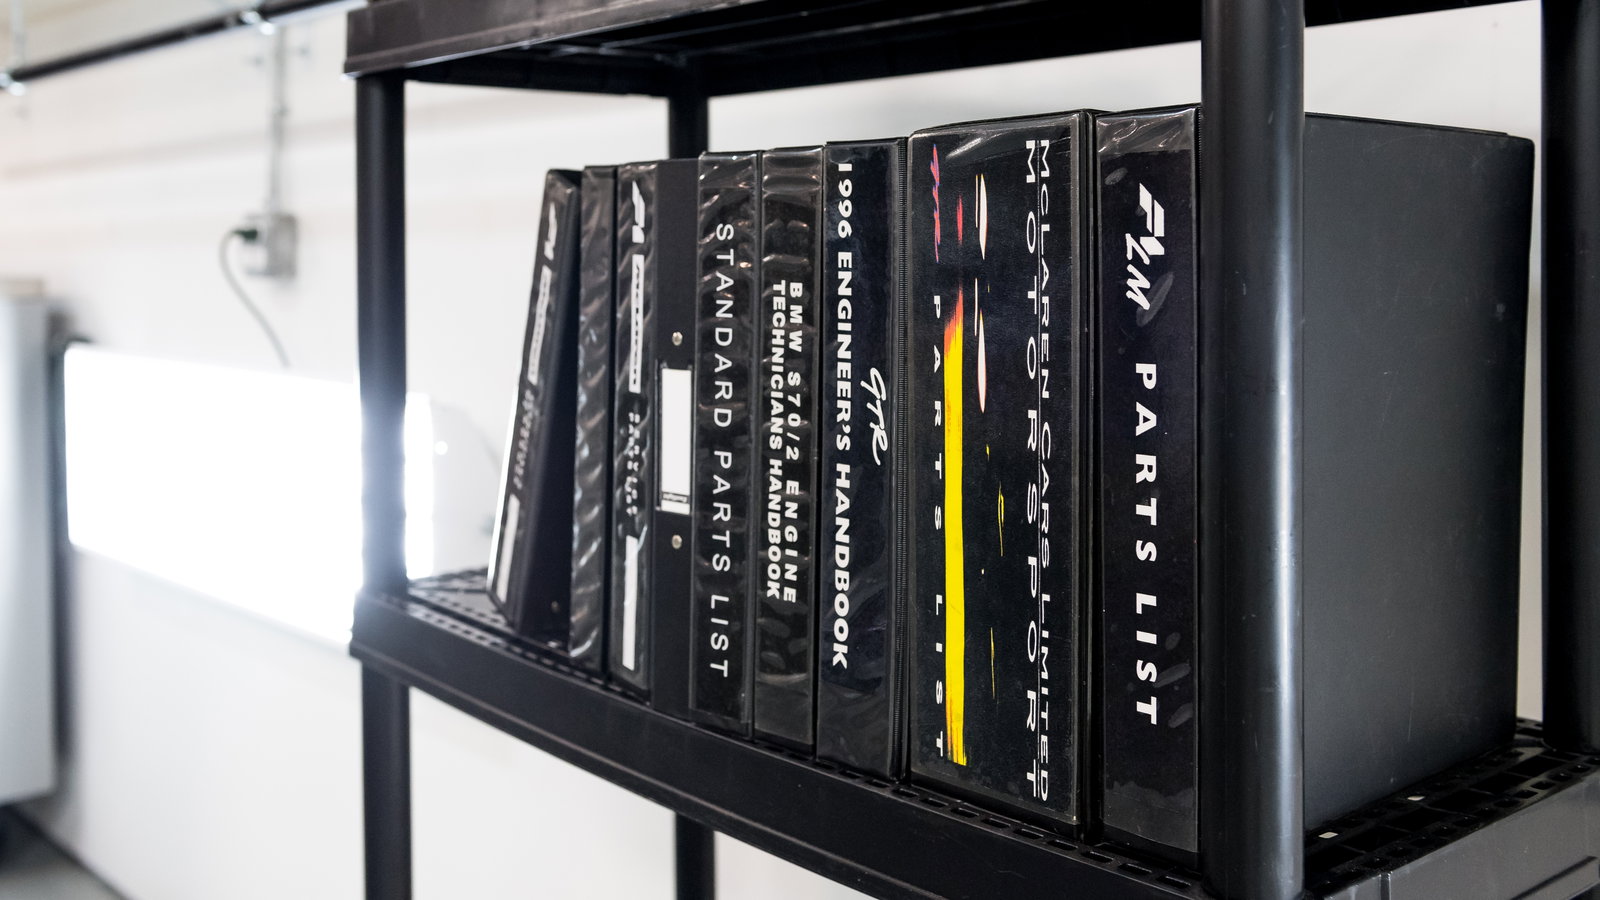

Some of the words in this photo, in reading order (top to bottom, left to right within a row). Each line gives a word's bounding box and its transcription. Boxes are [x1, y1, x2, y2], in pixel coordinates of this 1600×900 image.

[838, 163, 852, 238] 1996
[1139, 183, 1165, 255] F1
[714, 223, 734, 427] STANDARD
[789, 282, 802, 352] BMW
[1125, 233, 1150, 310] LM
[770, 280, 785, 449] TECHNICIANS
[786, 371, 801, 460] S70/2
[836, 252, 852, 451] ENGINEER'S
[860, 367, 888, 466] GTR
[933, 295, 941, 529] PARTS
[711, 451, 732, 571] PARTS
[767, 459, 782, 599] HANDBOOK
[1025, 140, 1037, 798] MOTORSPORT
[1041, 421, 1050, 568] CARS
[1135, 363, 1157, 562] PARTS
[783, 480, 799, 602] ENGINE
[833, 463, 850, 669] HANDBOOK
[710, 594, 730, 677] LIST
[935, 594, 943, 756] LIST
[1040, 594, 1050, 801] LIMITED
[1136, 592, 1157, 724] LIST
